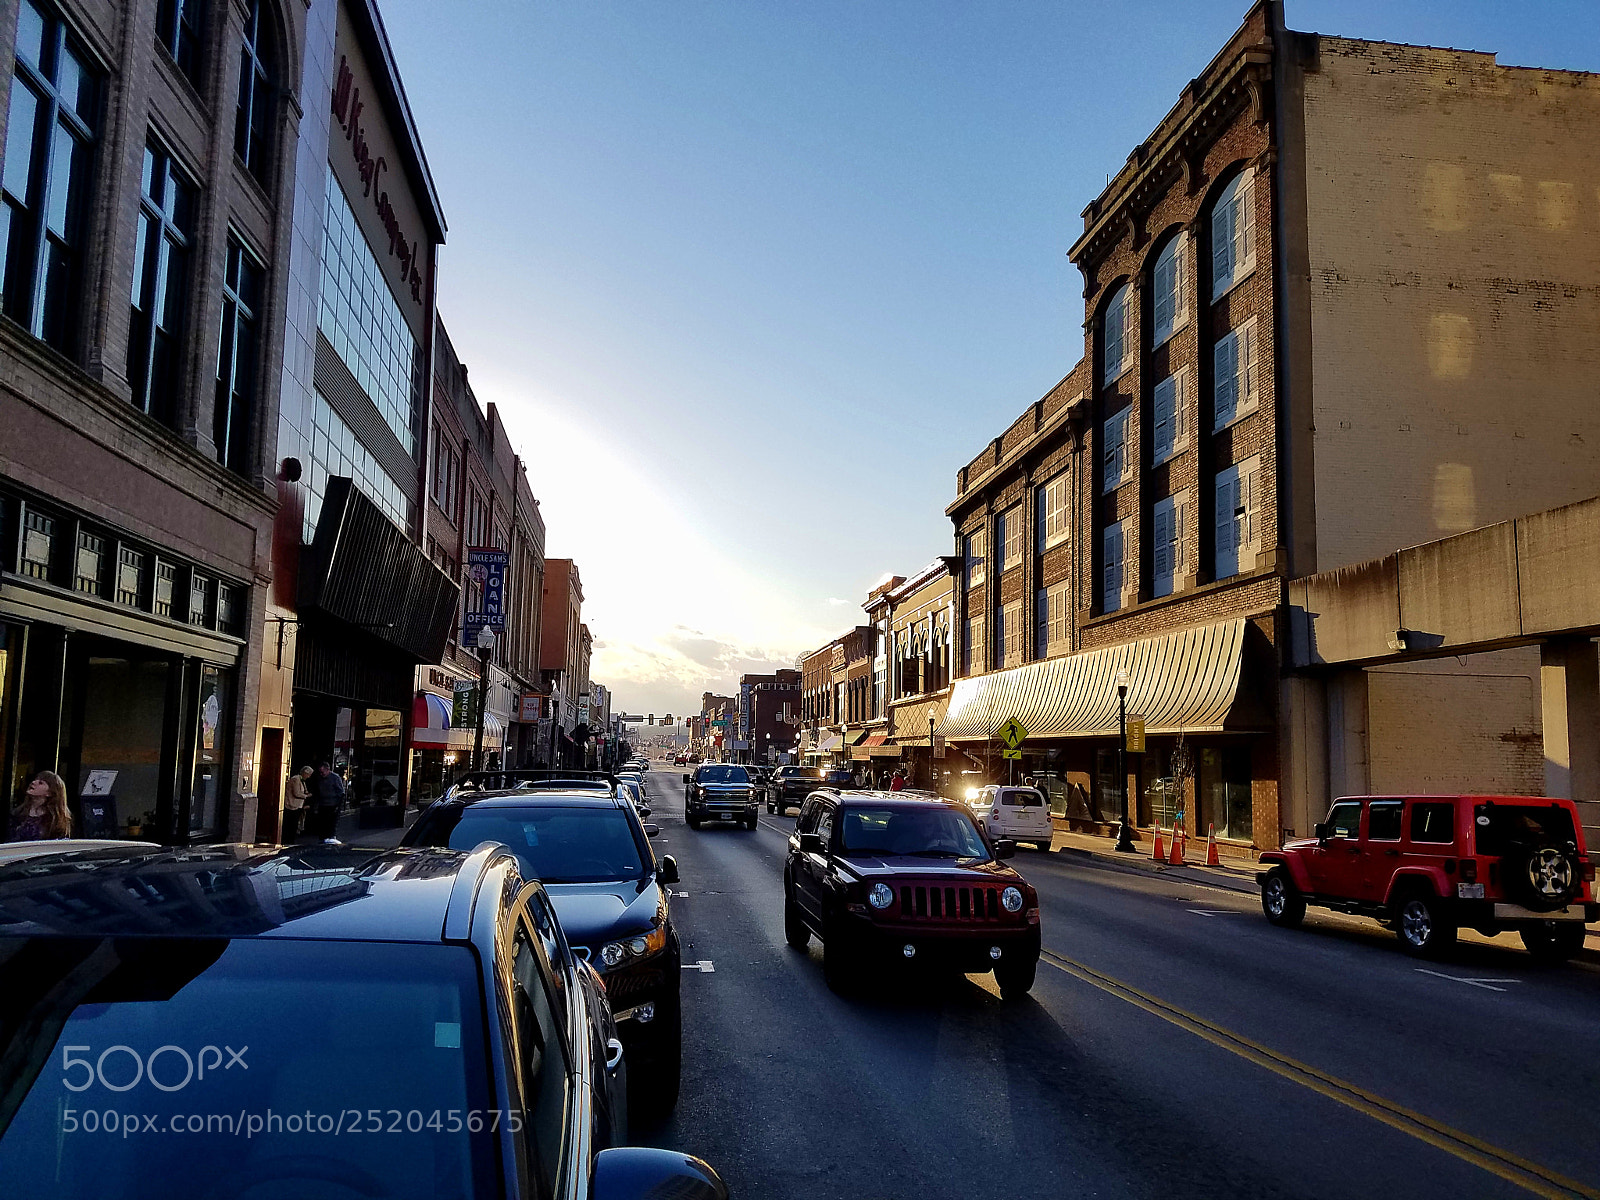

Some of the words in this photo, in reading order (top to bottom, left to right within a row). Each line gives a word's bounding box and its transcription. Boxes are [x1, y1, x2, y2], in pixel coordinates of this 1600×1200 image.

[487, 564, 501, 614] LOAN
[467, 614, 503, 624] OFFICE
[460, 691, 470, 728] STRONG
